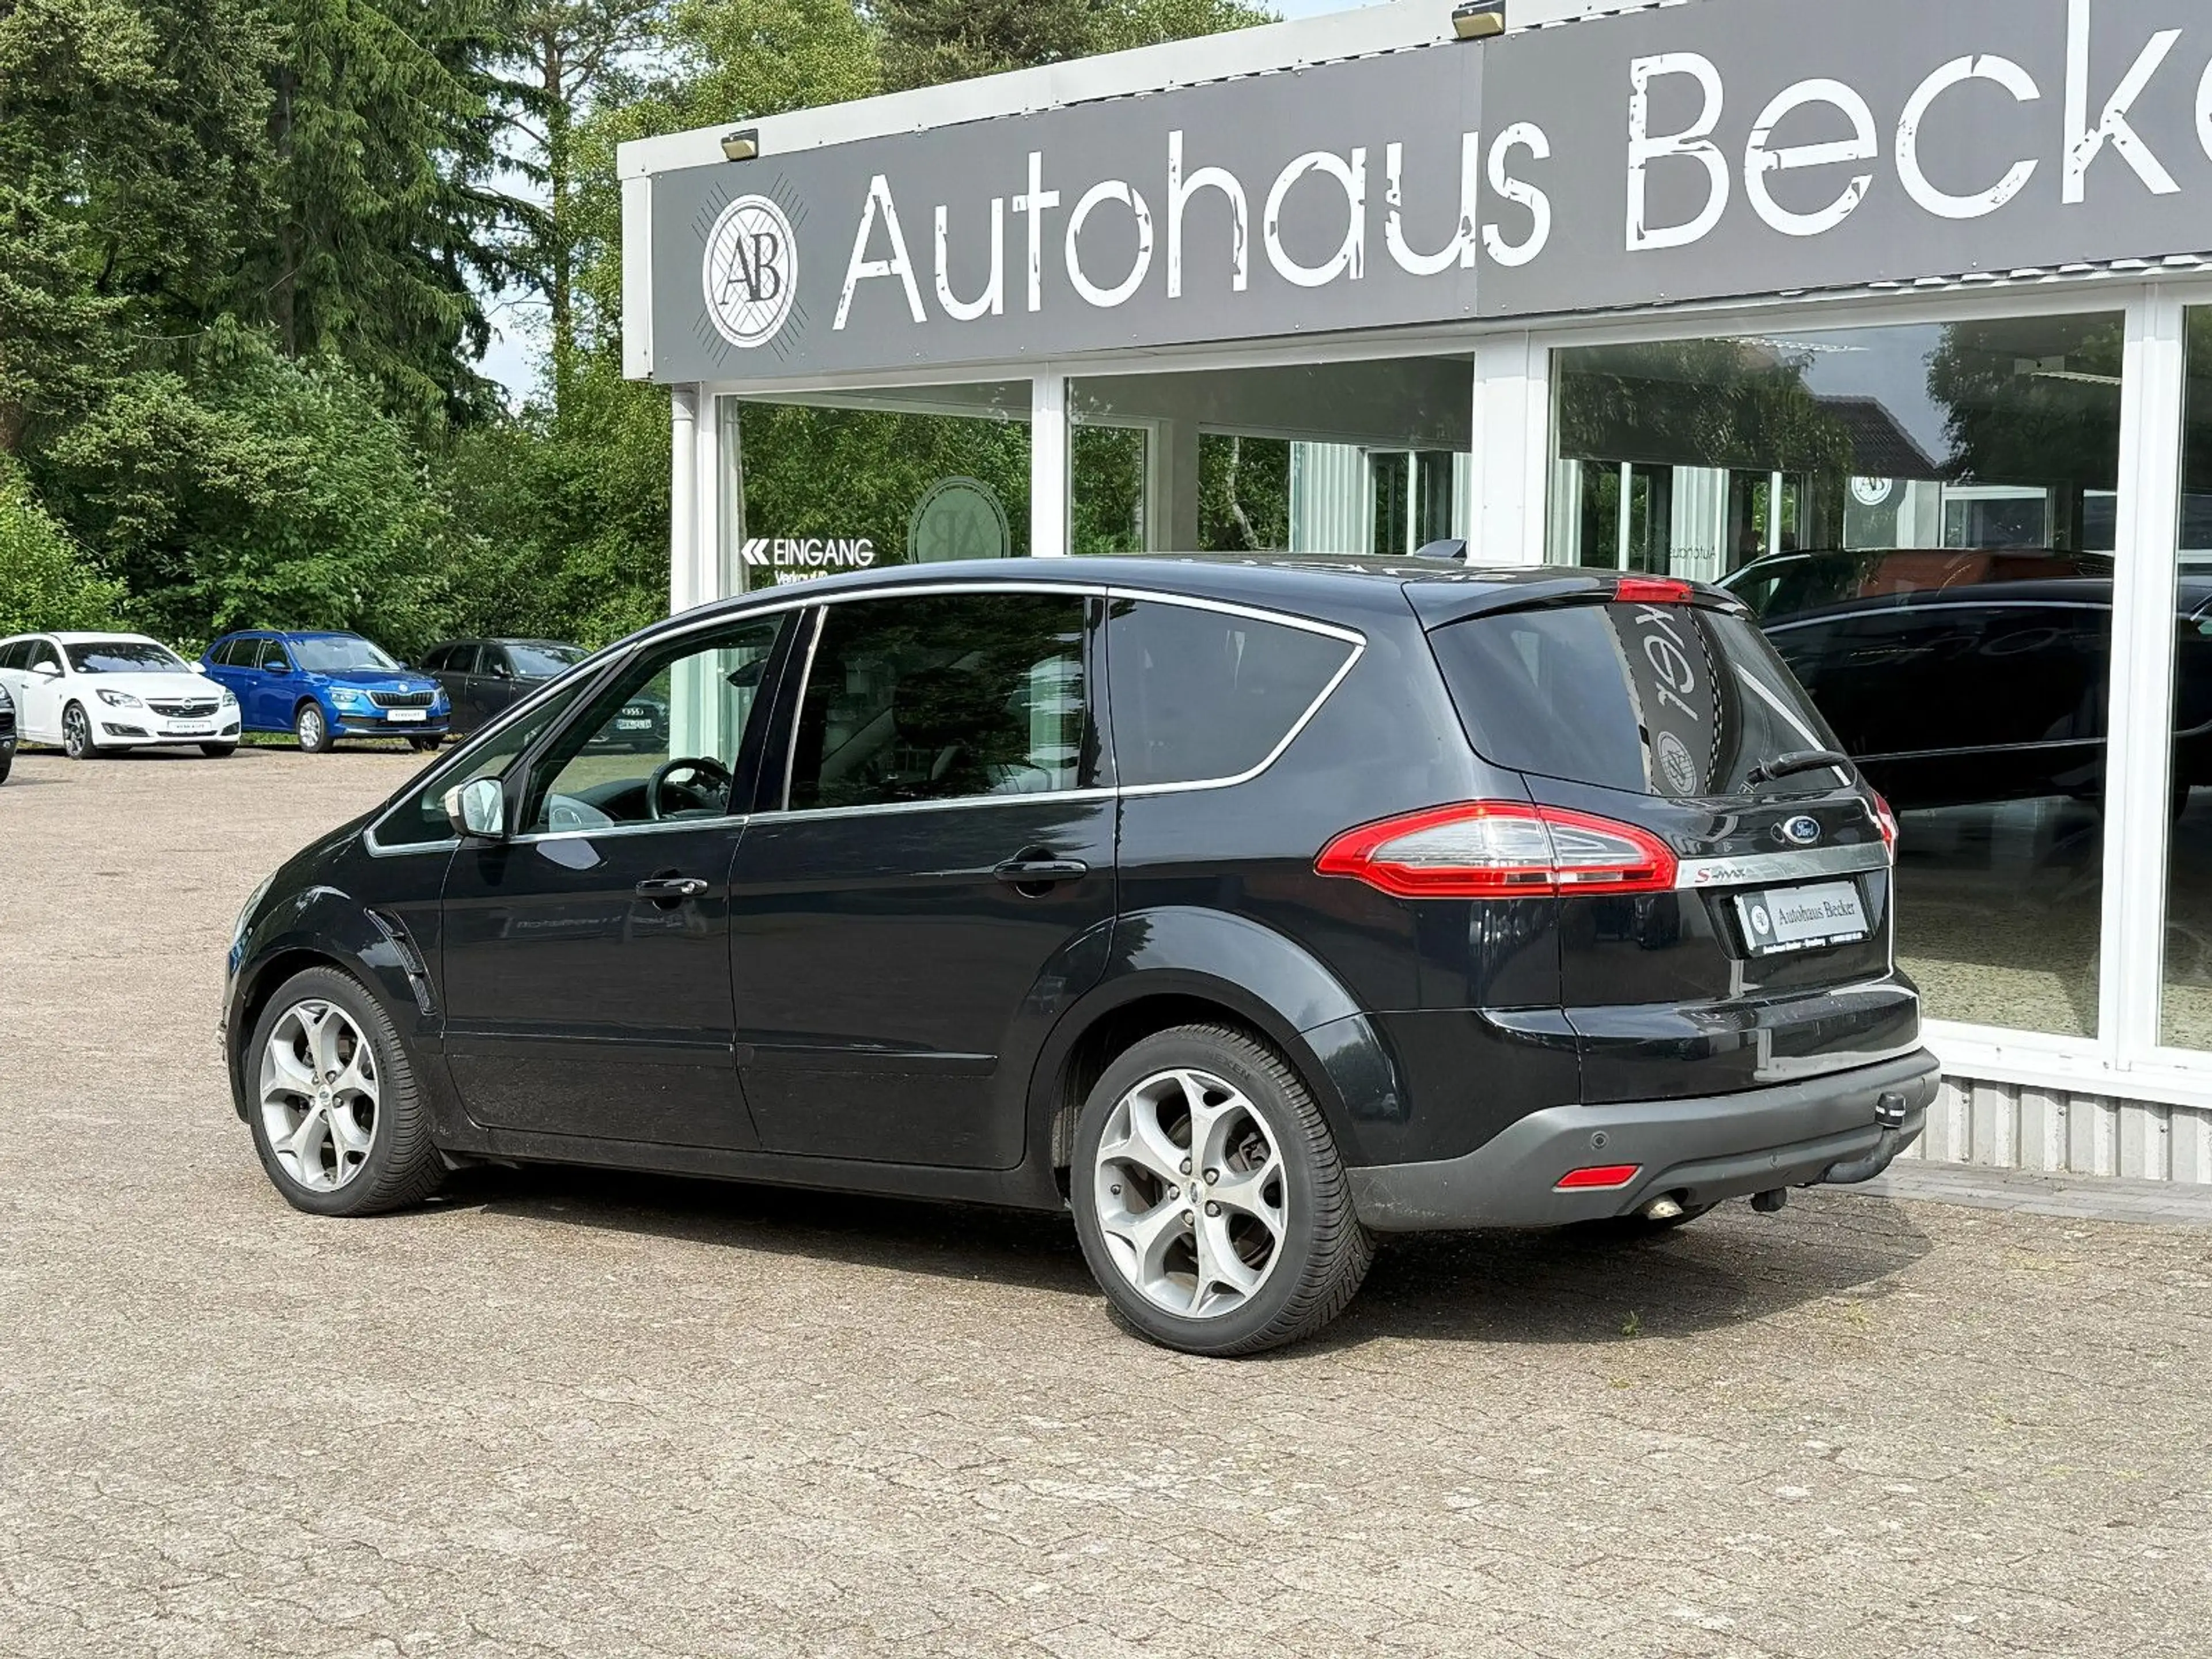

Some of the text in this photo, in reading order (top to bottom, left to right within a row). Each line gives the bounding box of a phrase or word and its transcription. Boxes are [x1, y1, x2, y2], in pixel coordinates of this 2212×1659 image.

[833, 0, 2212, 330] Autohaus Beck
[718, 232, 780, 305] AB
[774, 539, 874, 566] EINGANG
[1778, 904, 1824, 925] Autohaus
[1823, 900, 1854, 918] Becker
